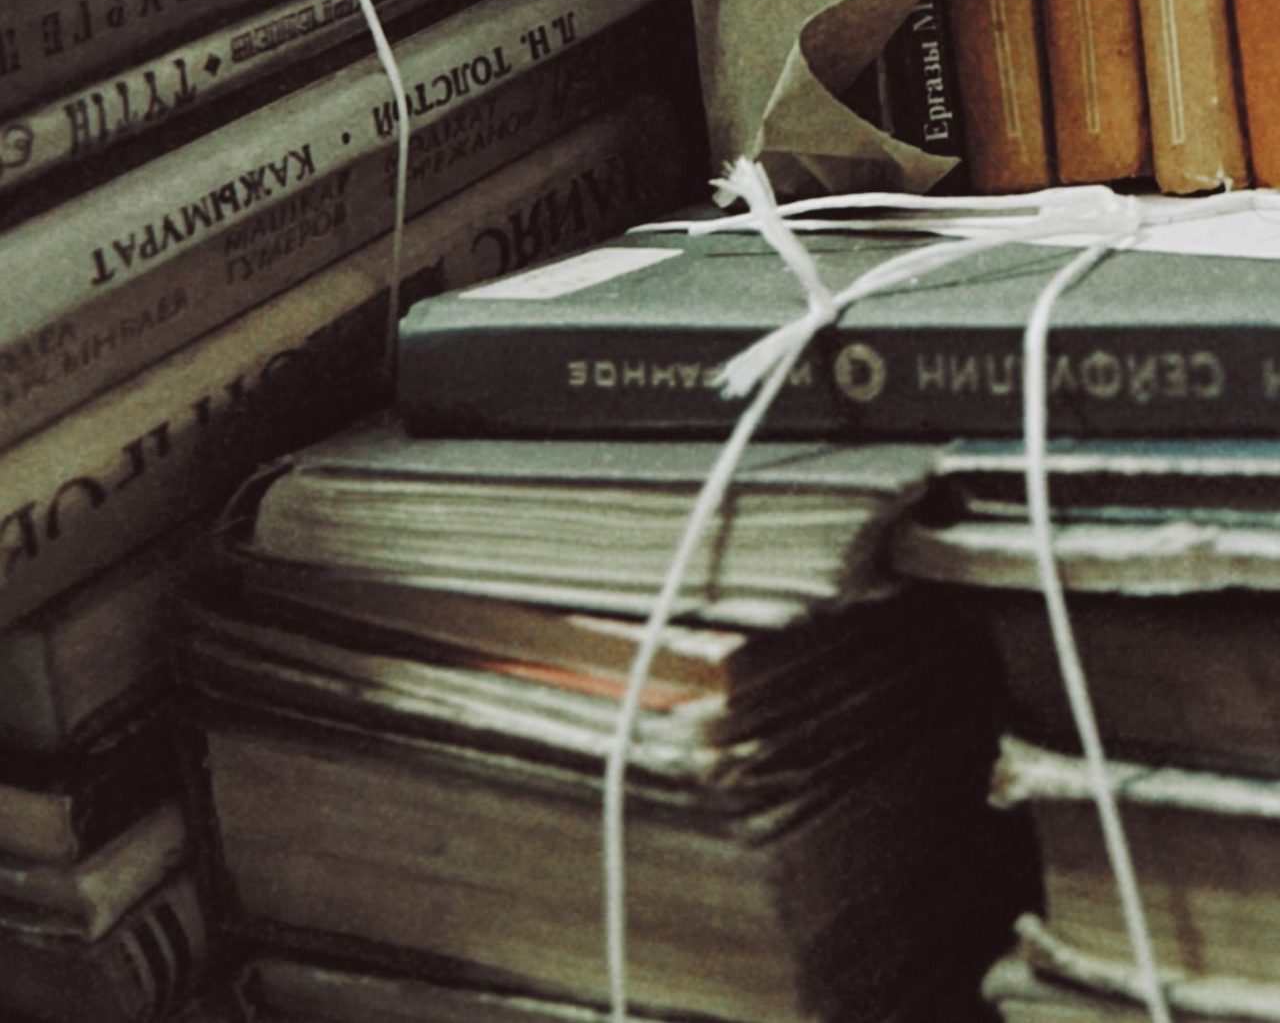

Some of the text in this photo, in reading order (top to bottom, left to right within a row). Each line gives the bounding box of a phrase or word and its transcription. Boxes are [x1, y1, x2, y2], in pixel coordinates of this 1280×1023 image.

[917, 40, 952, 142] Ергазы
[566, 360, 812, 387] ИРАННОЕ
[914, 349, 1224, 400] СЕЙФУЛИН
